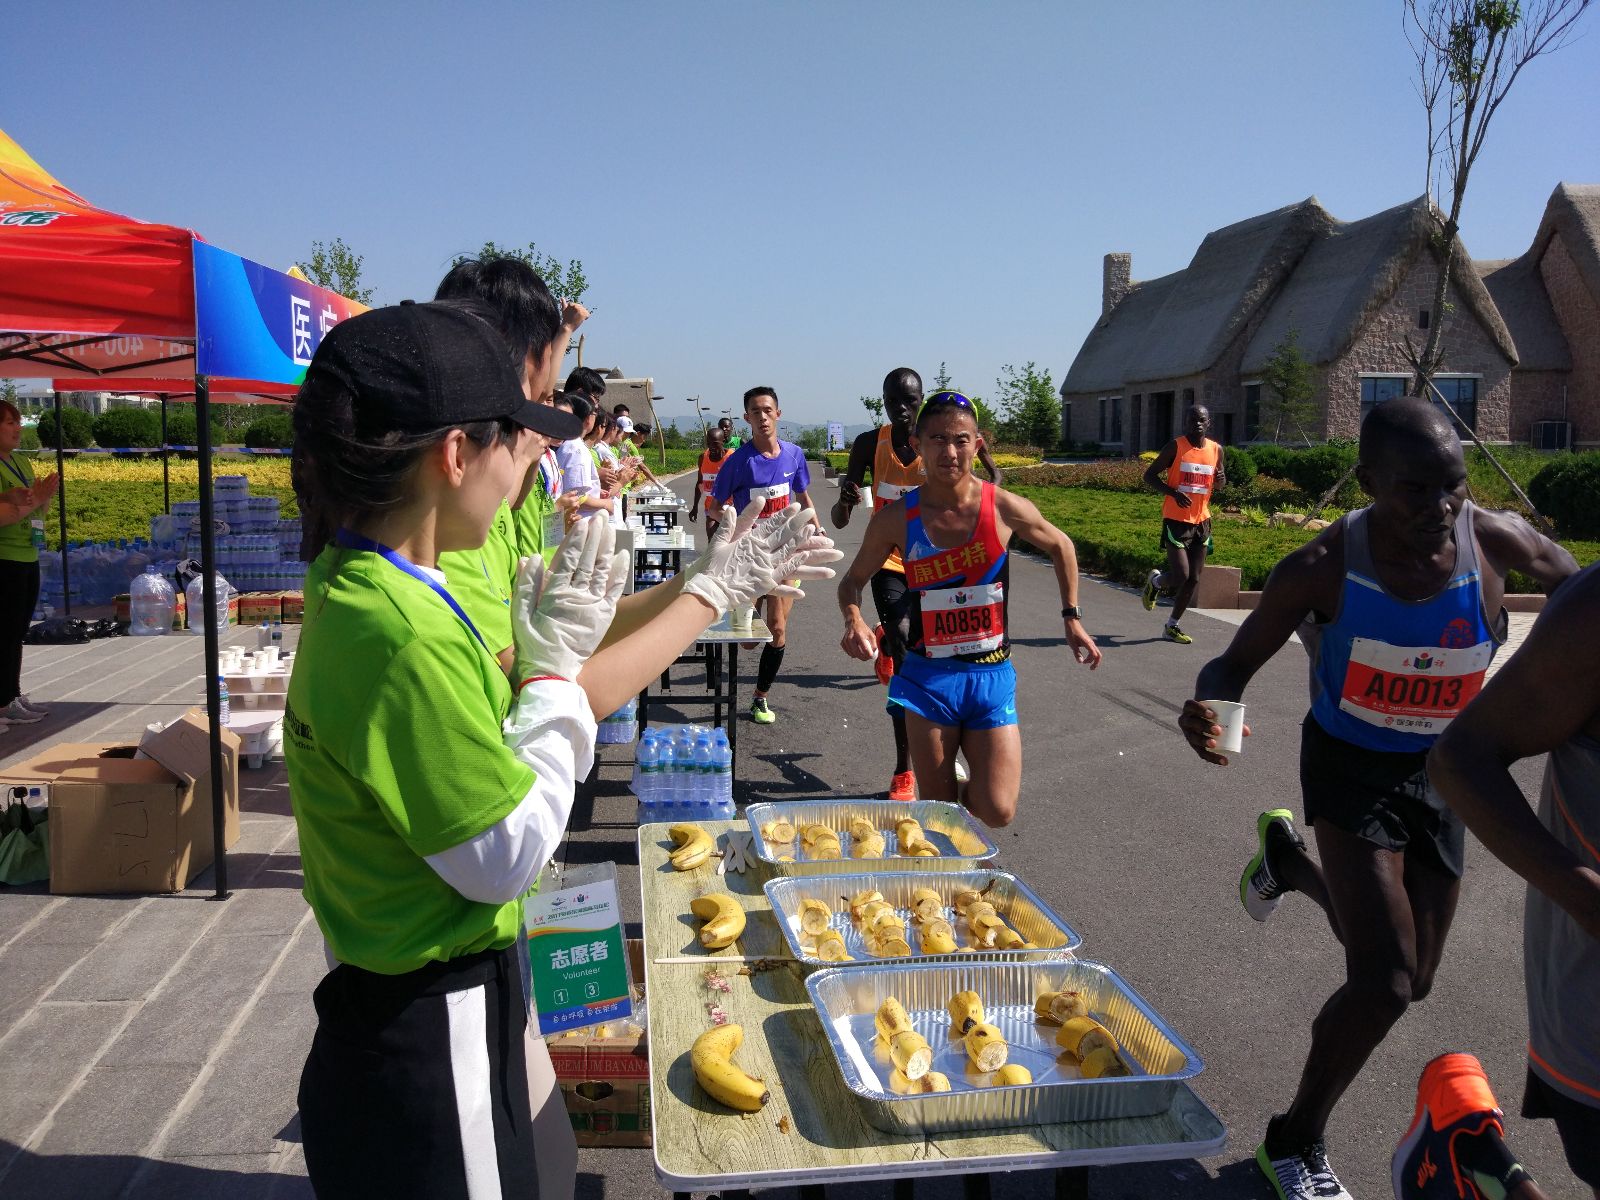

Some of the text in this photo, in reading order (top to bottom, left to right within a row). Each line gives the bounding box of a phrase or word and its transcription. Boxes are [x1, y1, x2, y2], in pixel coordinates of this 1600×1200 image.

[914, 542, 986, 583] 康比特
[934, 607, 993, 637] A0858
[1365, 673, 1463, 706] A0013
[550, 939, 608, 970] 志愿者
[562, 966, 601, 981] Volunteer
[556, 983, 597, 1003] 1 3
